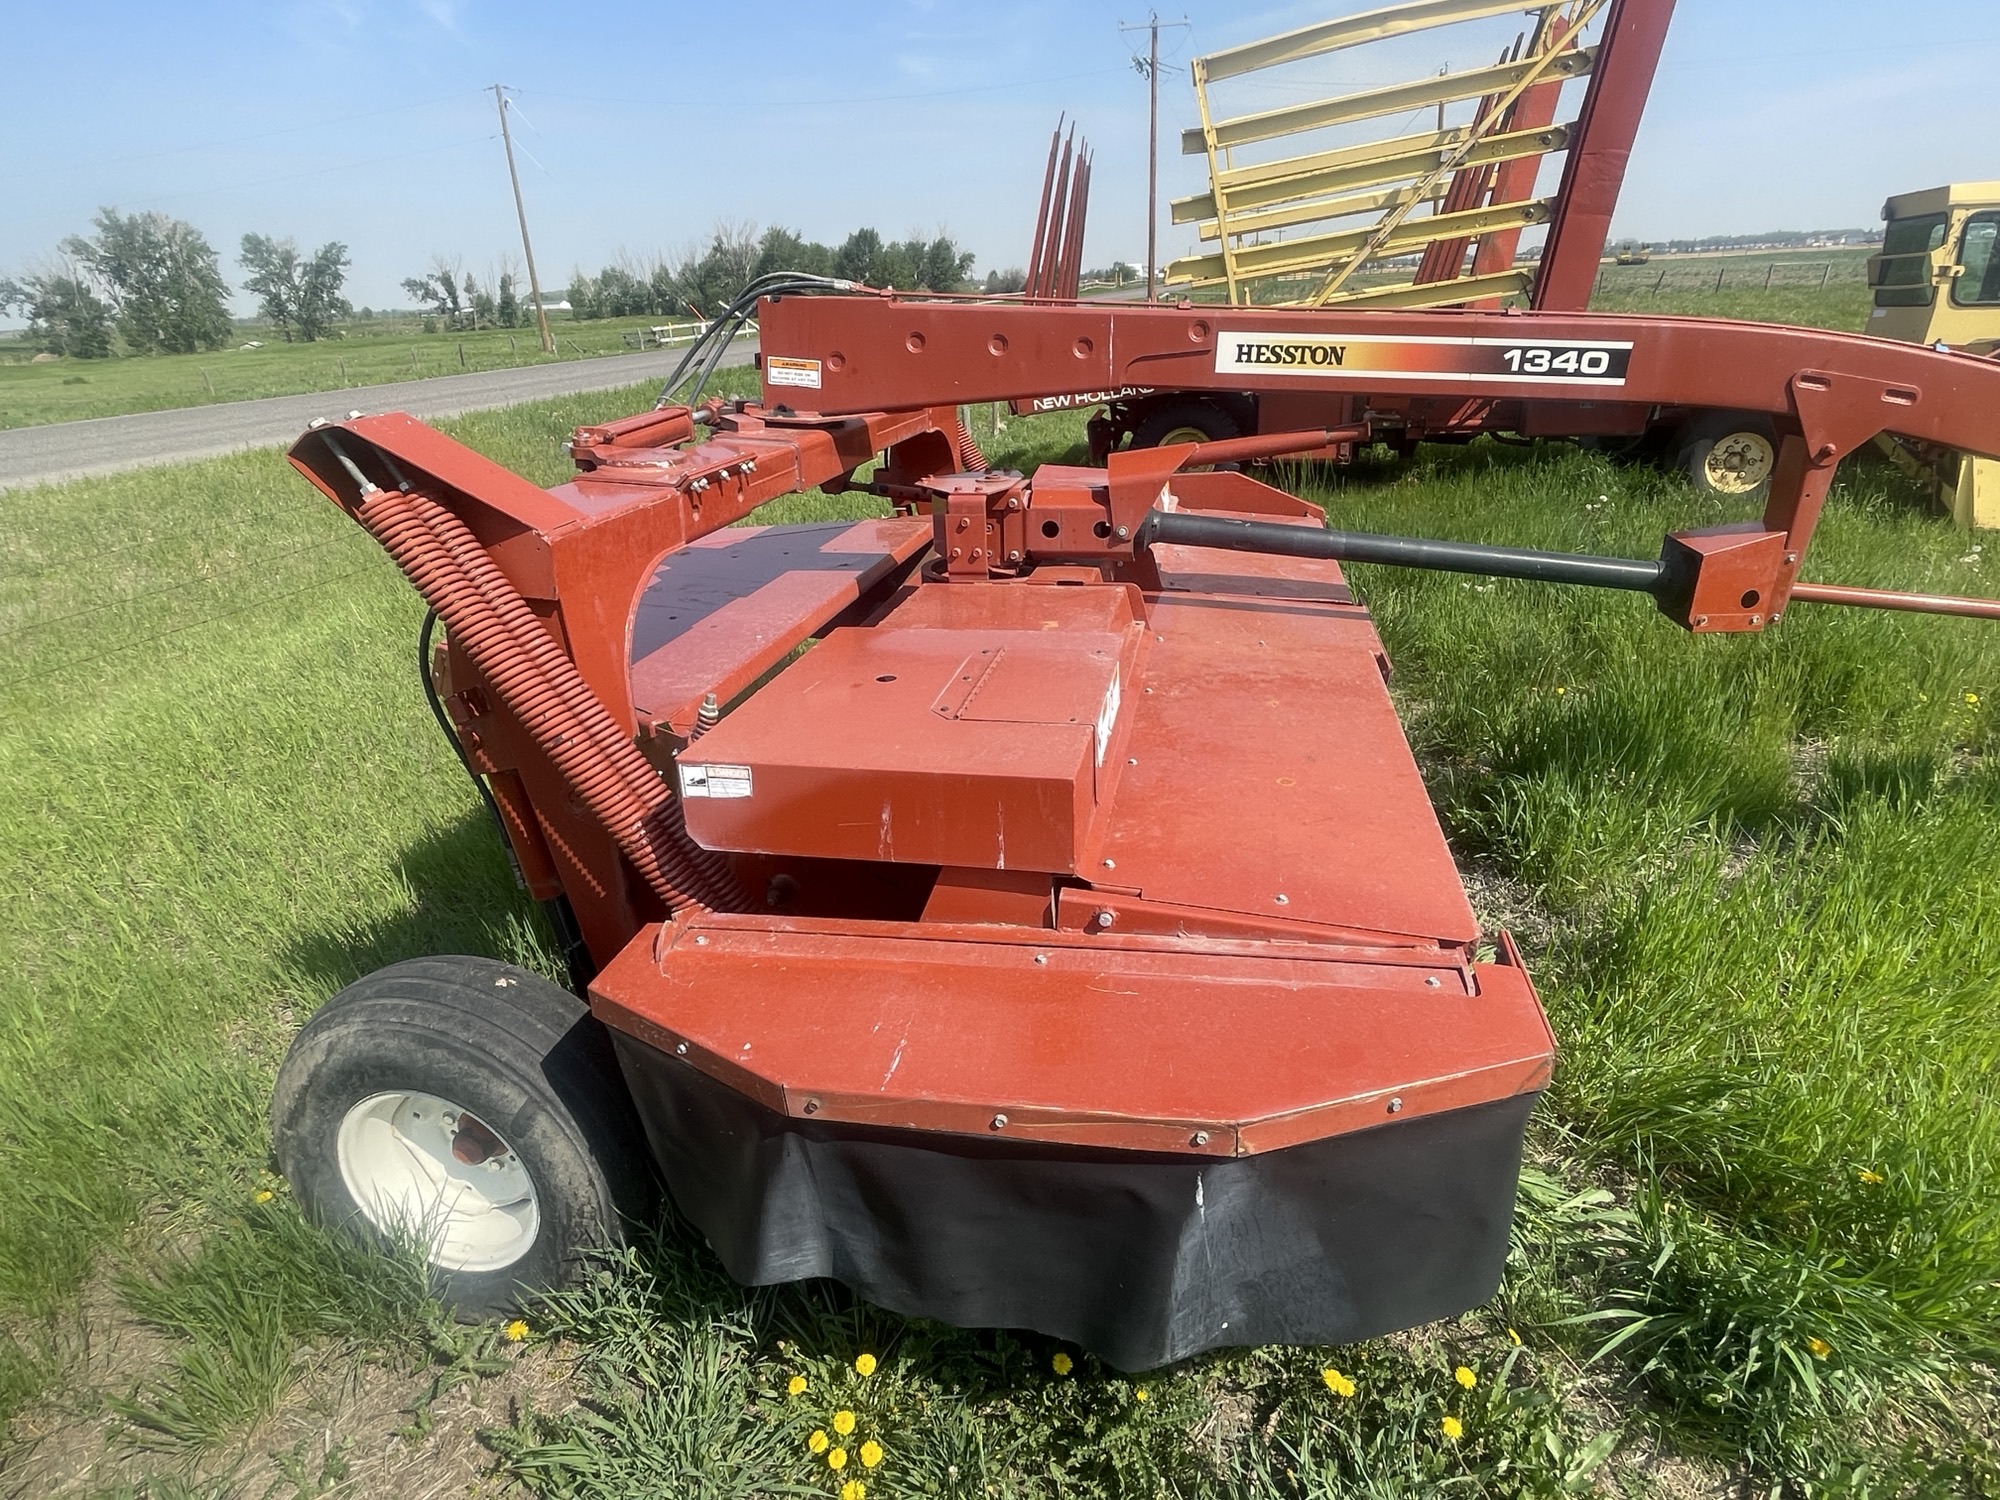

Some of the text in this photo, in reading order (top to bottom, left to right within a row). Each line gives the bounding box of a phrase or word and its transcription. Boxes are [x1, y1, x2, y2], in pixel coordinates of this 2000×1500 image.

[1235, 344, 1610, 374] HESSTON 1340
[1033, 387, 1155, 411] NEW HOLLAN
